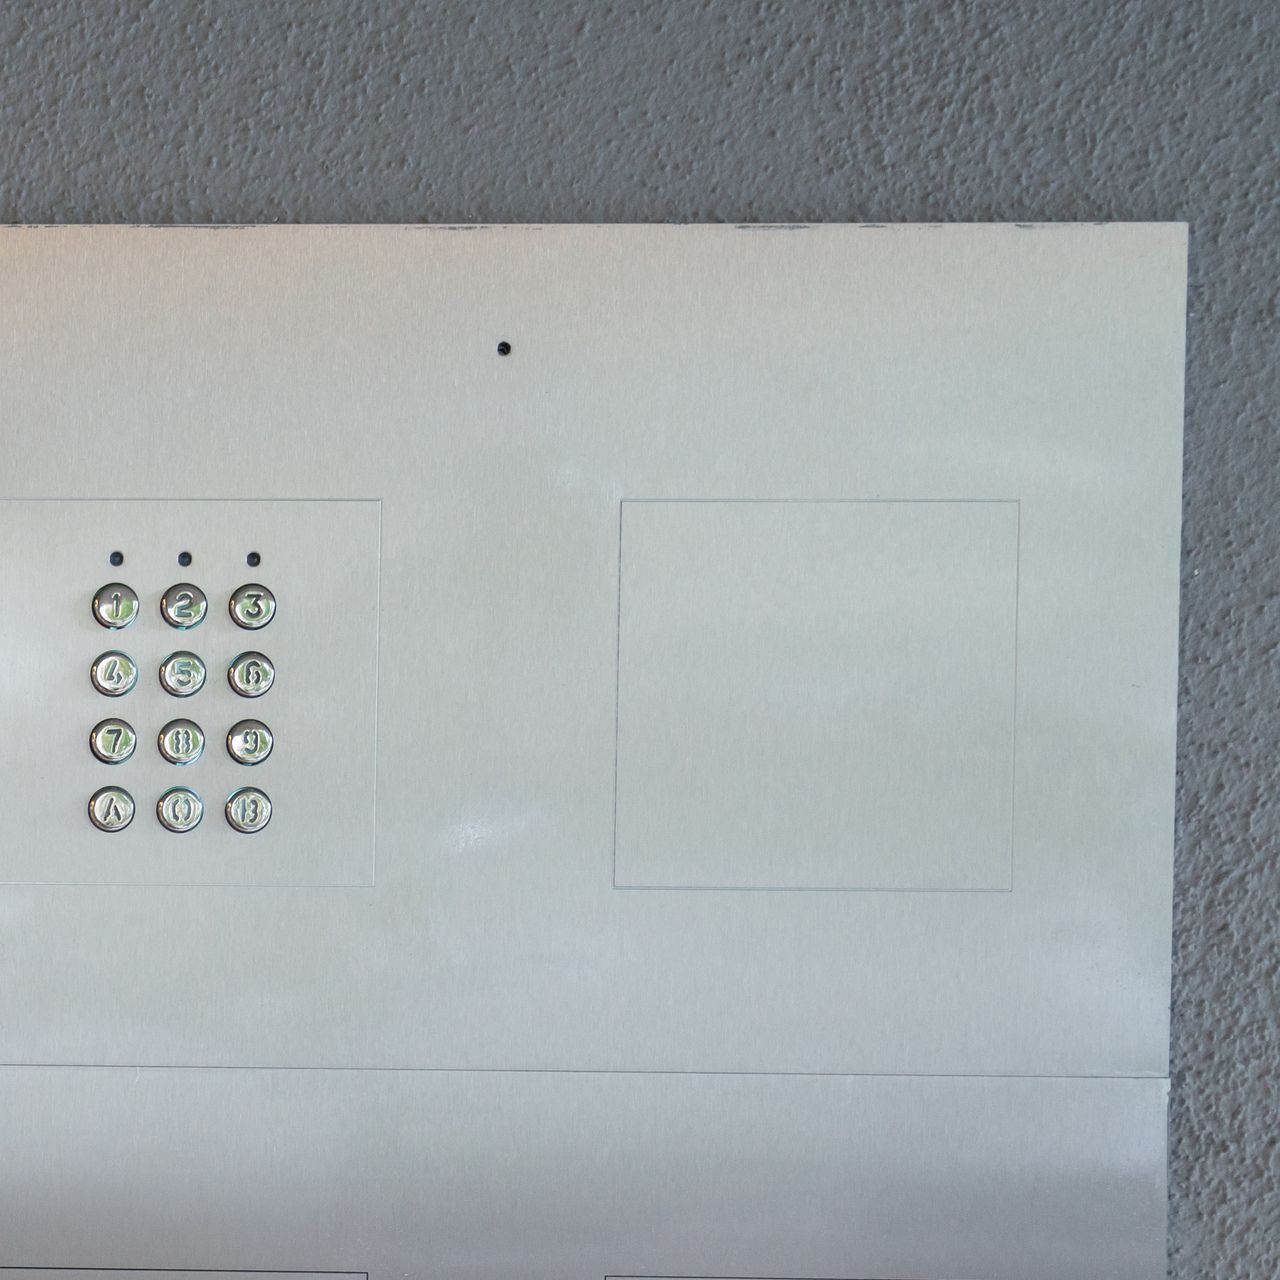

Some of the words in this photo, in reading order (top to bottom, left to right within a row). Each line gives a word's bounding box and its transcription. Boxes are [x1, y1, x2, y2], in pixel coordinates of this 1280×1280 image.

[174, 590, 194, 618] 2
[244, 591, 265, 619] 3
[104, 658, 124, 686] 4
[174, 660, 194, 687] 5
[244, 659, 263, 687] 6
[105, 728, 123, 754] 7
[173, 728, 193, 755] 8
[242, 728, 260, 755] 9
[103, 796, 122, 823] A
